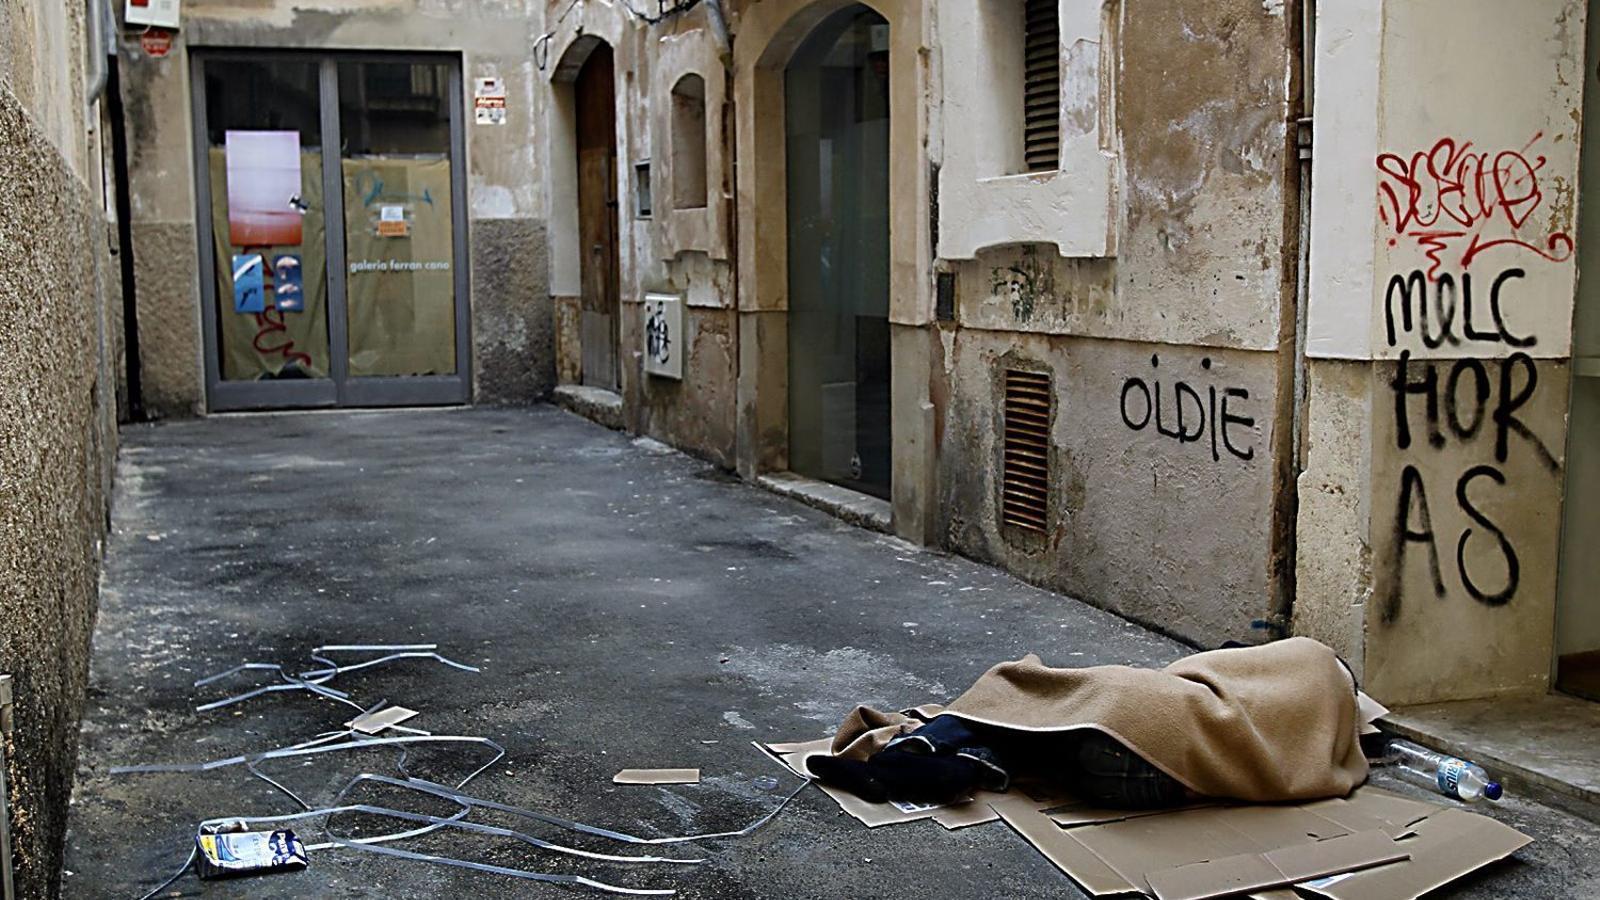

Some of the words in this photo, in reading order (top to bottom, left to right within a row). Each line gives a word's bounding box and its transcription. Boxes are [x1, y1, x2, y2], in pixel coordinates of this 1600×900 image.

[350, 259, 387, 273] galeria
[390, 259, 422, 270] ferran
[425, 262, 449, 270] cano
[1391, 349, 1560, 470] HOR
[1381, 465, 1520, 624] AS
